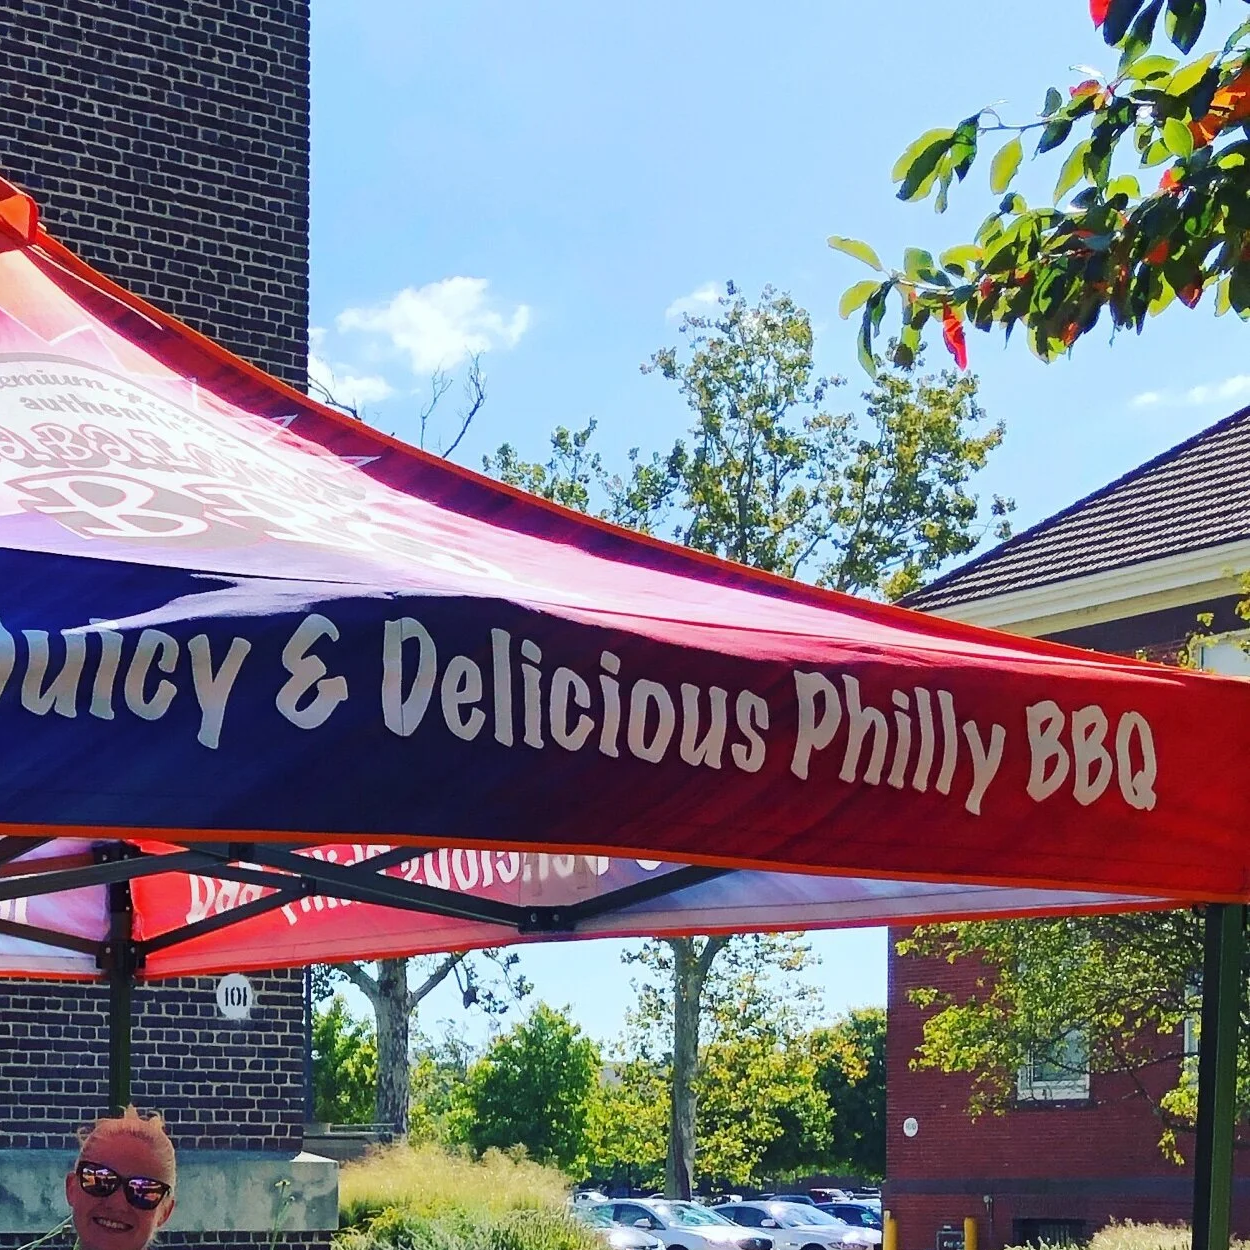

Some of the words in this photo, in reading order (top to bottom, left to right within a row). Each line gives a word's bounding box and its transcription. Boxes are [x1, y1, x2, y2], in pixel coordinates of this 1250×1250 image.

[276, 613, 348, 729] &
[382, 617, 769, 773] Delicious
[791, 670, 1006, 815] Philly
[1026, 700, 1157, 811] BBQ
[225, 987, 247, 1006] 101
